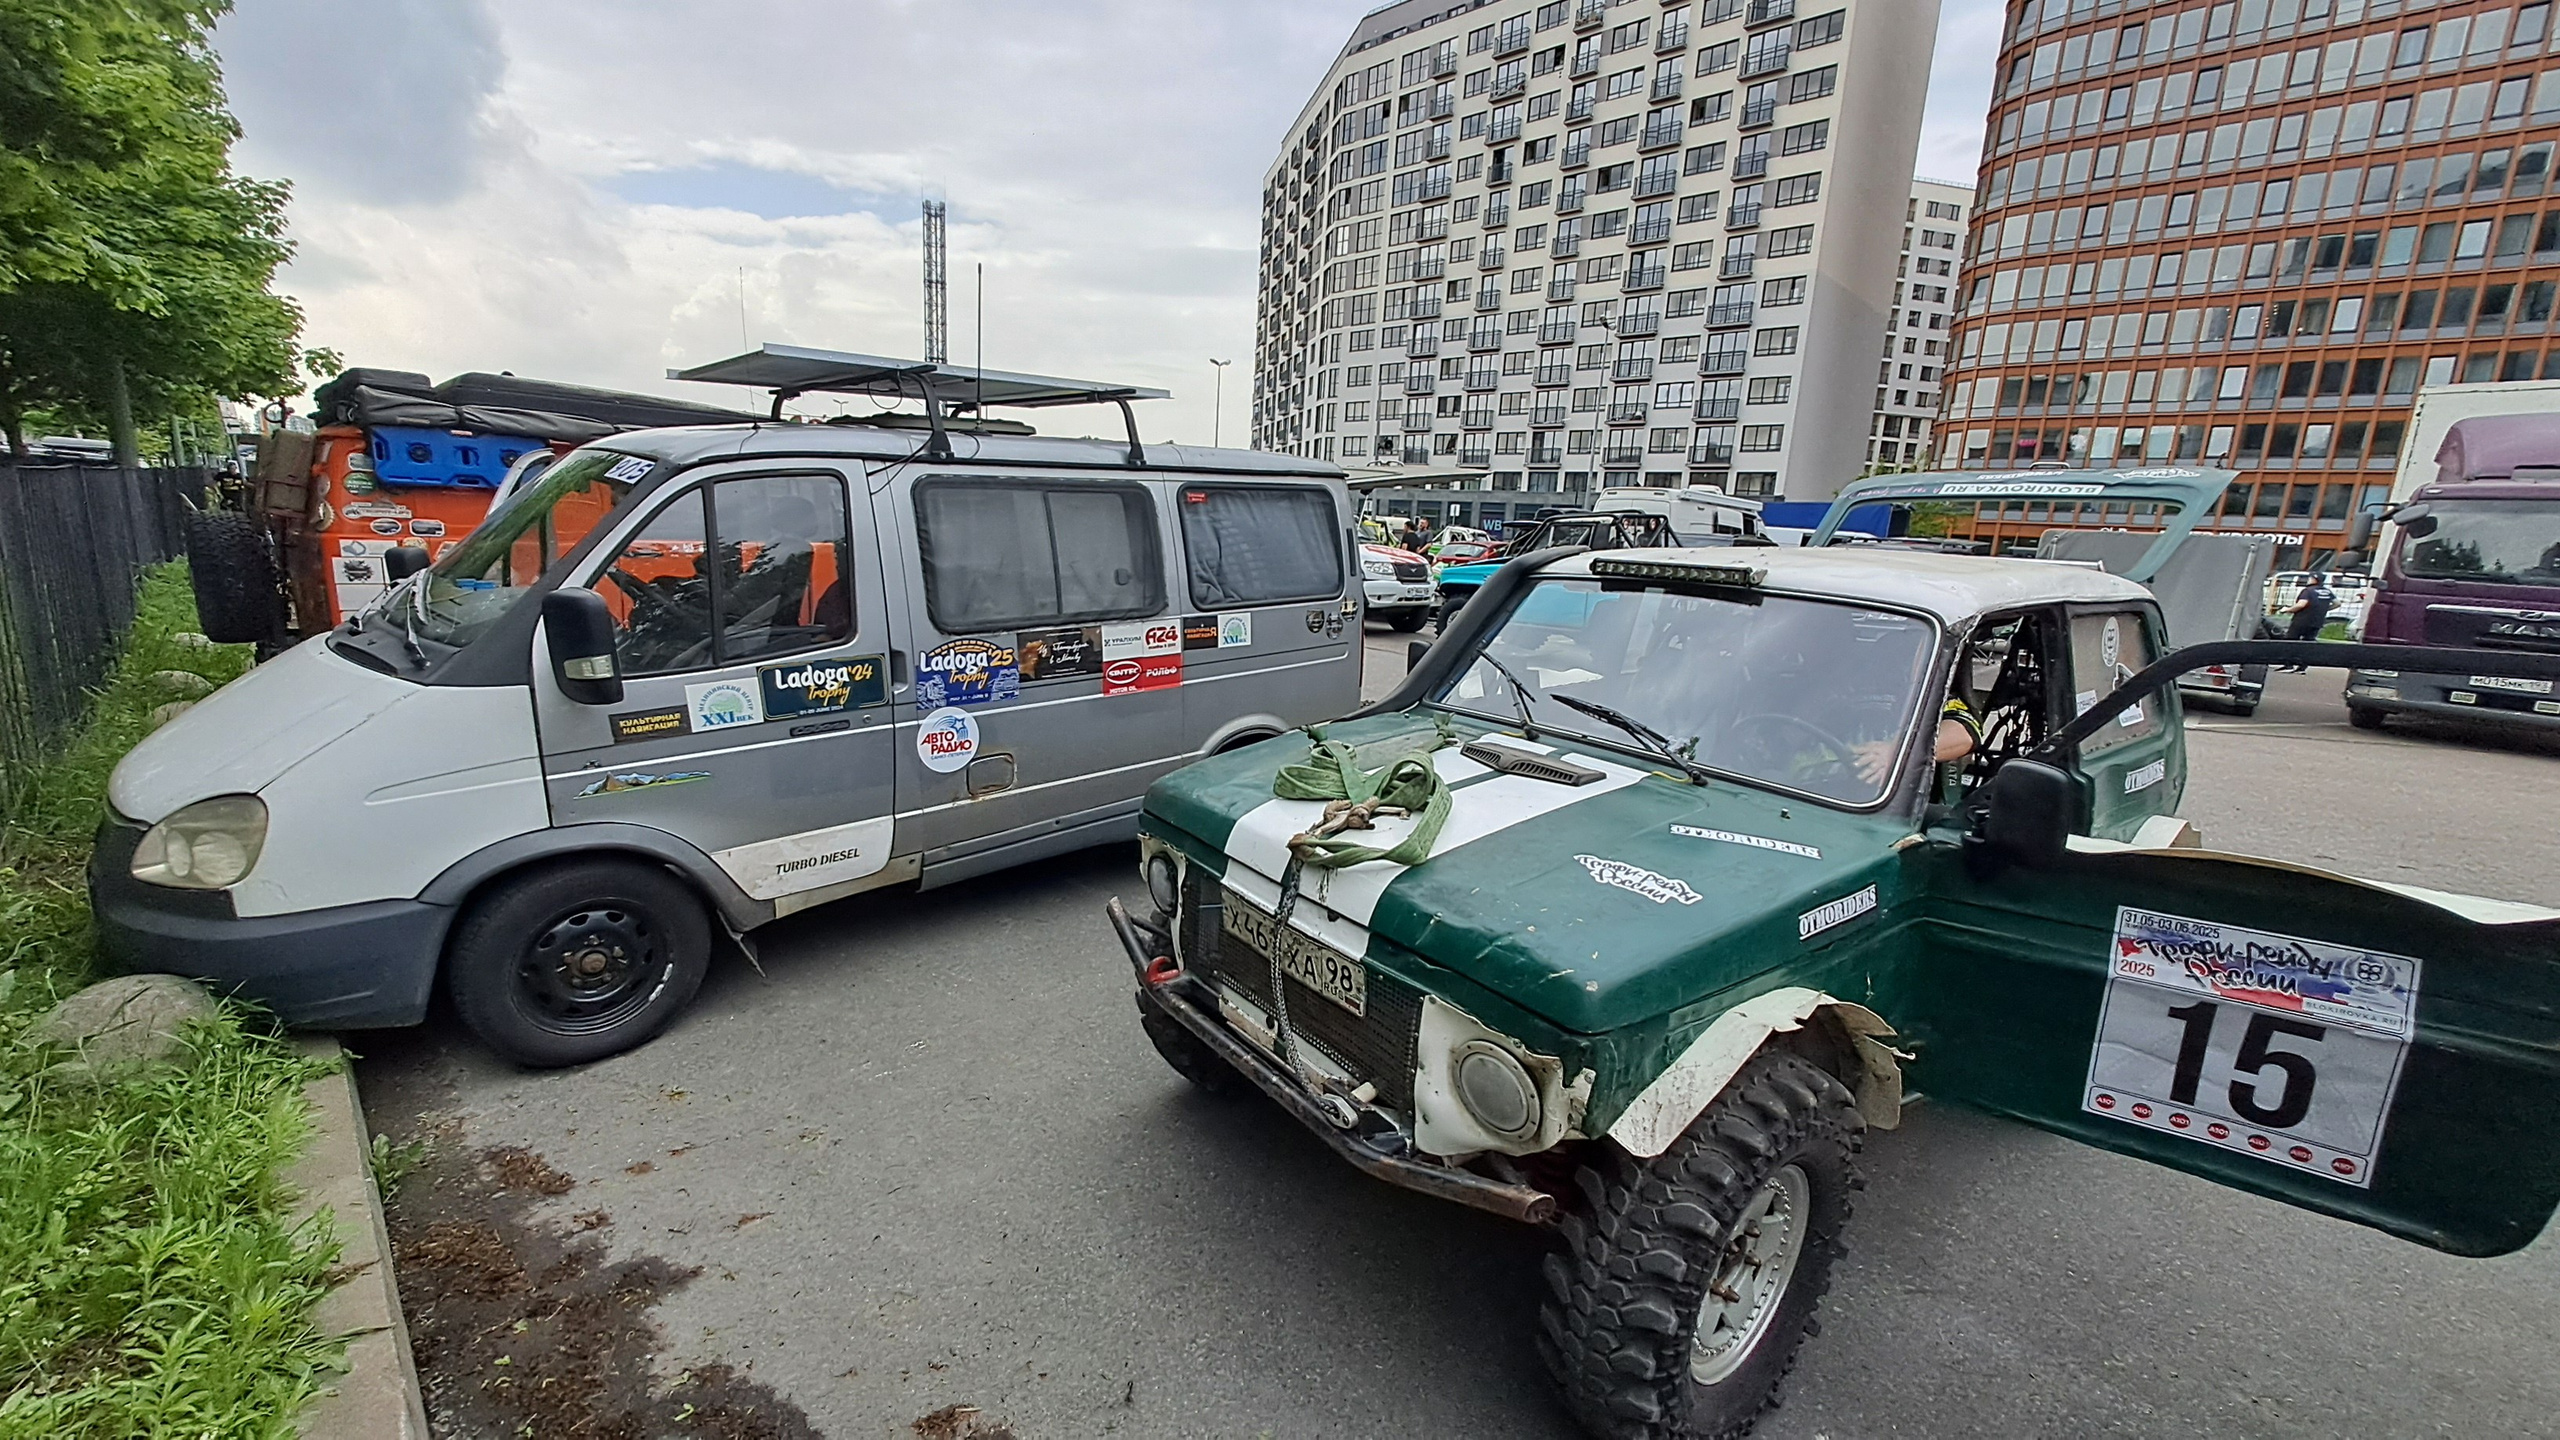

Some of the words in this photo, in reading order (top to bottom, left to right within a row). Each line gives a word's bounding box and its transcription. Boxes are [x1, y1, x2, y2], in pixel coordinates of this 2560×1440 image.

[608, 460, 654, 480] 905
[1944, 485, 2098, 495] BLOKIROVKA.RU
[1483, 519, 1503, 531] WB
[2489, 622, 2560, 638] MAN
[949, 669, 989, 691] Trophy
[1108, 667, 1139, 677] SINTEC
[1145, 666, 1178, 678] РОЛЬФ
[808, 680, 851, 707] Trophy
[1109, 686, 1128, 695] MOTOR
[619, 713, 681, 728] КУЛЬТУРНАЯ
[623, 720, 680, 735] НАВИГАЦИЯ
[701, 711, 736, 727] XXI
[737, 713, 754, 722] ВЕК
[920, 731, 955, 746] АВТО
[930, 739, 972, 755] РАДИО
[775, 856, 818, 875] TURBO
[819, 847, 860, 866] DIESEL
[1799, 887, 1876, 936] OTMORIDERS
[2124, 911, 2220, 940] 31.05-03.06.2025
[1325, 956, 1354, 992] 98
[2119, 958, 2156, 978] 2025
[1322, 981, 1345, 1001] RUS
[2305, 1001, 2398, 1026] BLOKIROVKA.RU
[2167, 1000, 2327, 1129] 15
